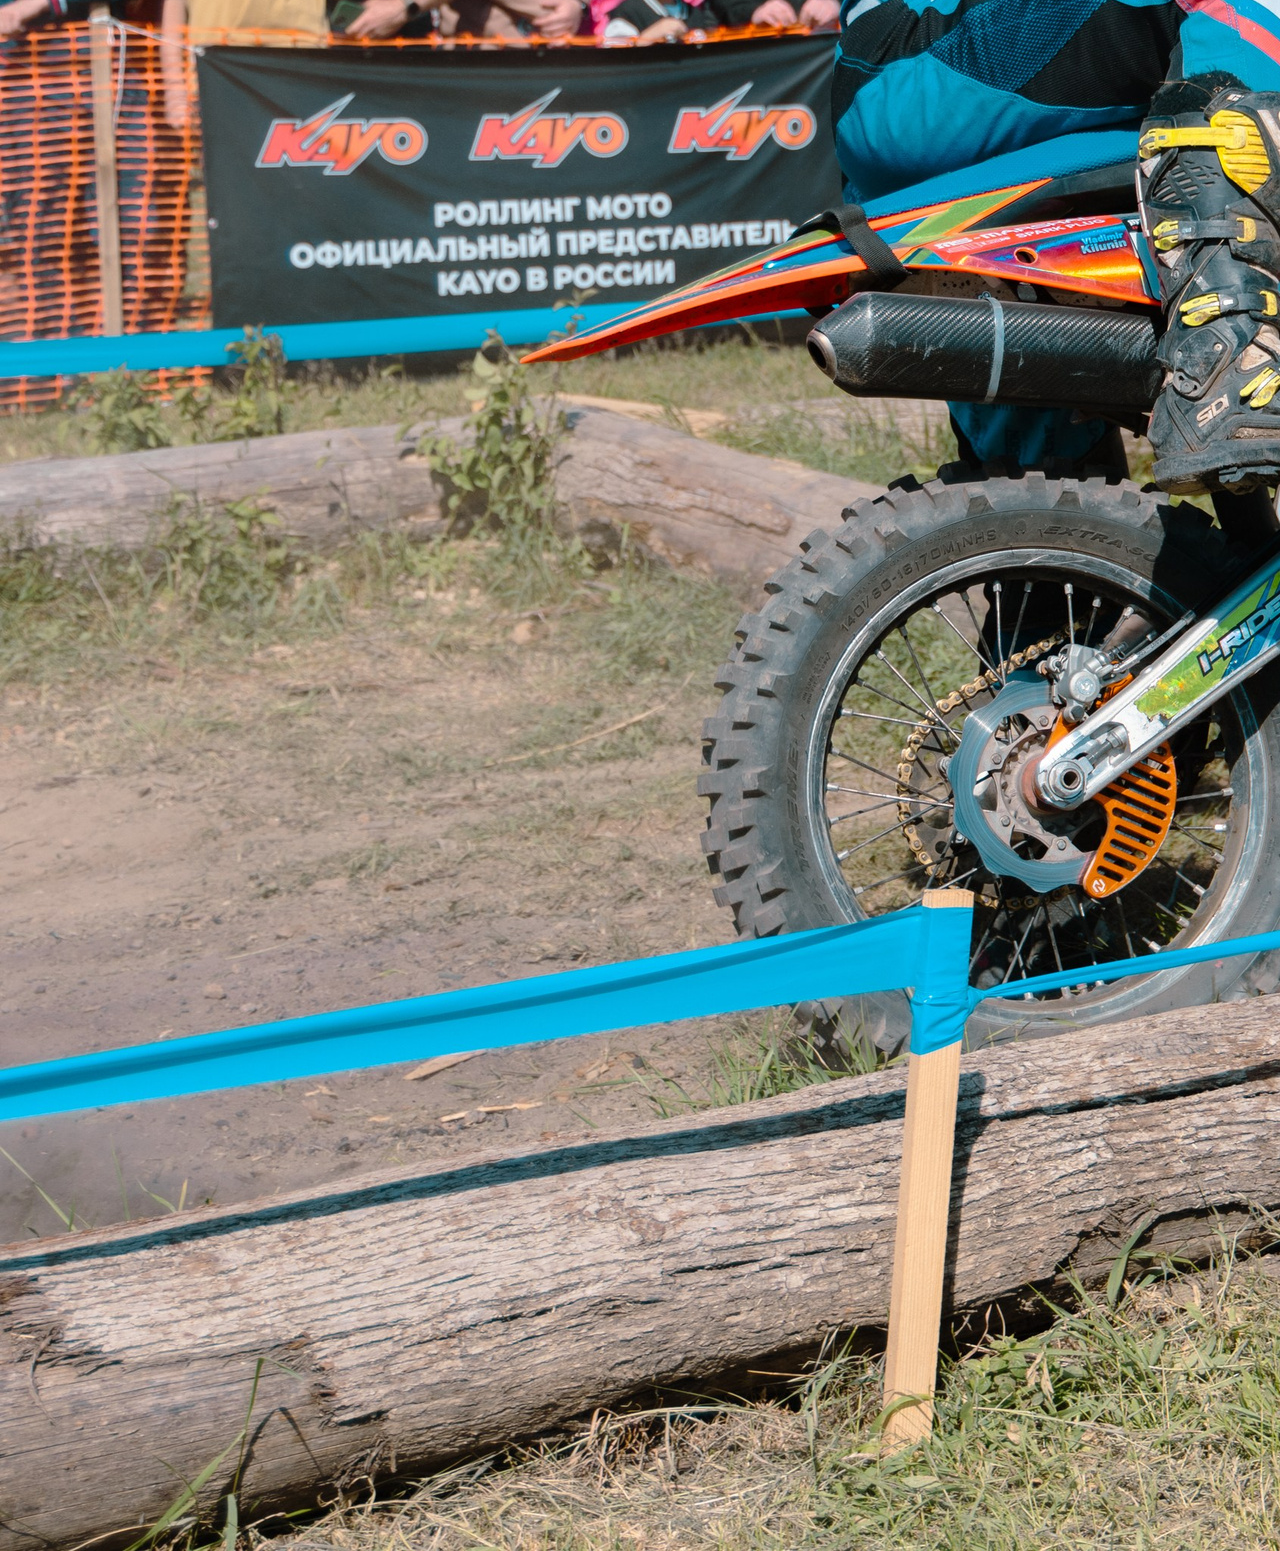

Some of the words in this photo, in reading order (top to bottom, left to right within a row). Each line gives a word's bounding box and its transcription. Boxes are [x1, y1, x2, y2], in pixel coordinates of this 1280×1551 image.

[255, 92, 429, 176] KAYO
[469, 87, 630, 168] KAYO
[668, 82, 818, 160] KAYO
[433, 196, 581, 228] РОЛЛИНГ
[586, 192, 673, 222] МОТО
[1015, 225, 1066, 240] SPARK
[1067, 218, 1105, 230] PLUG
[1081, 231, 1124, 246] Vladimir
[289, 226, 551, 269] ОФИЦИАЛЬНЫЙ
[1081, 239, 1128, 255] Kilunin
[526, 265, 549, 292] В
[553, 259, 677, 291] РОССИИ
[961, 528, 998, 549] NHS
[1043, 525, 1124, 549] EXTRA
[1129, 546, 1158, 563] SO
[786, 743, 835, 923] EXTREME
